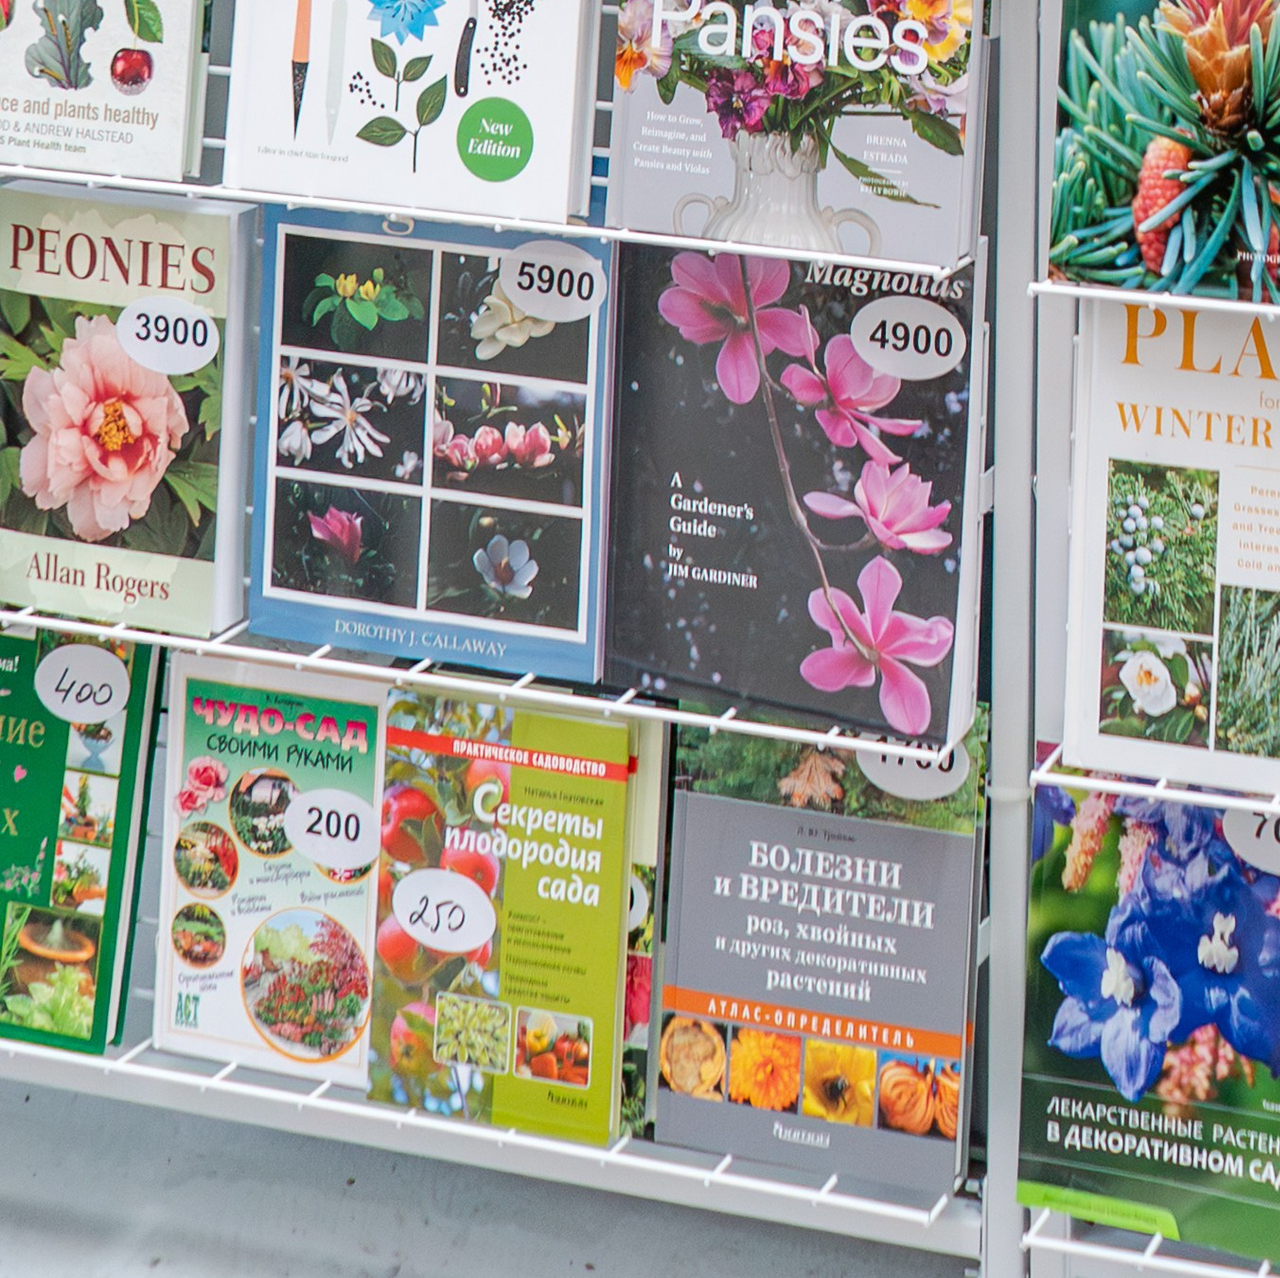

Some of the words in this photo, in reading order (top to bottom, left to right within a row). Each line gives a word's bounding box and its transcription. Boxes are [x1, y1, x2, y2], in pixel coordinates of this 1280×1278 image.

[10, 224, 216, 294] PEONIES
[516, 262, 595, 302] 5900
[135, 313, 208, 348] 3900
[870, 320, 953, 356] 4900
[1116, 402, 1272, 448] WINTER
[26, 552, 86, 587] Allan
[94, 562, 170, 604] Rogers
[55, 668, 112, 706] 400
[192, 696, 368, 752] ЧУДО-САД
[206, 732, 280, 762] СВОИМИ
[285, 744, 354, 774] РУКАМИ
[306, 807, 361, 843] 200
[472, 783, 603, 838] Секреты
[444, 825, 602, 874] плодородия
[749, 840, 902, 889] БОЛЕЗНИ
[537, 875, 600, 908] сада
[714, 877, 732, 896] и
[738, 873, 935, 929] ВРЕДИТЕЛИ
[409, 896, 465, 932] 250
